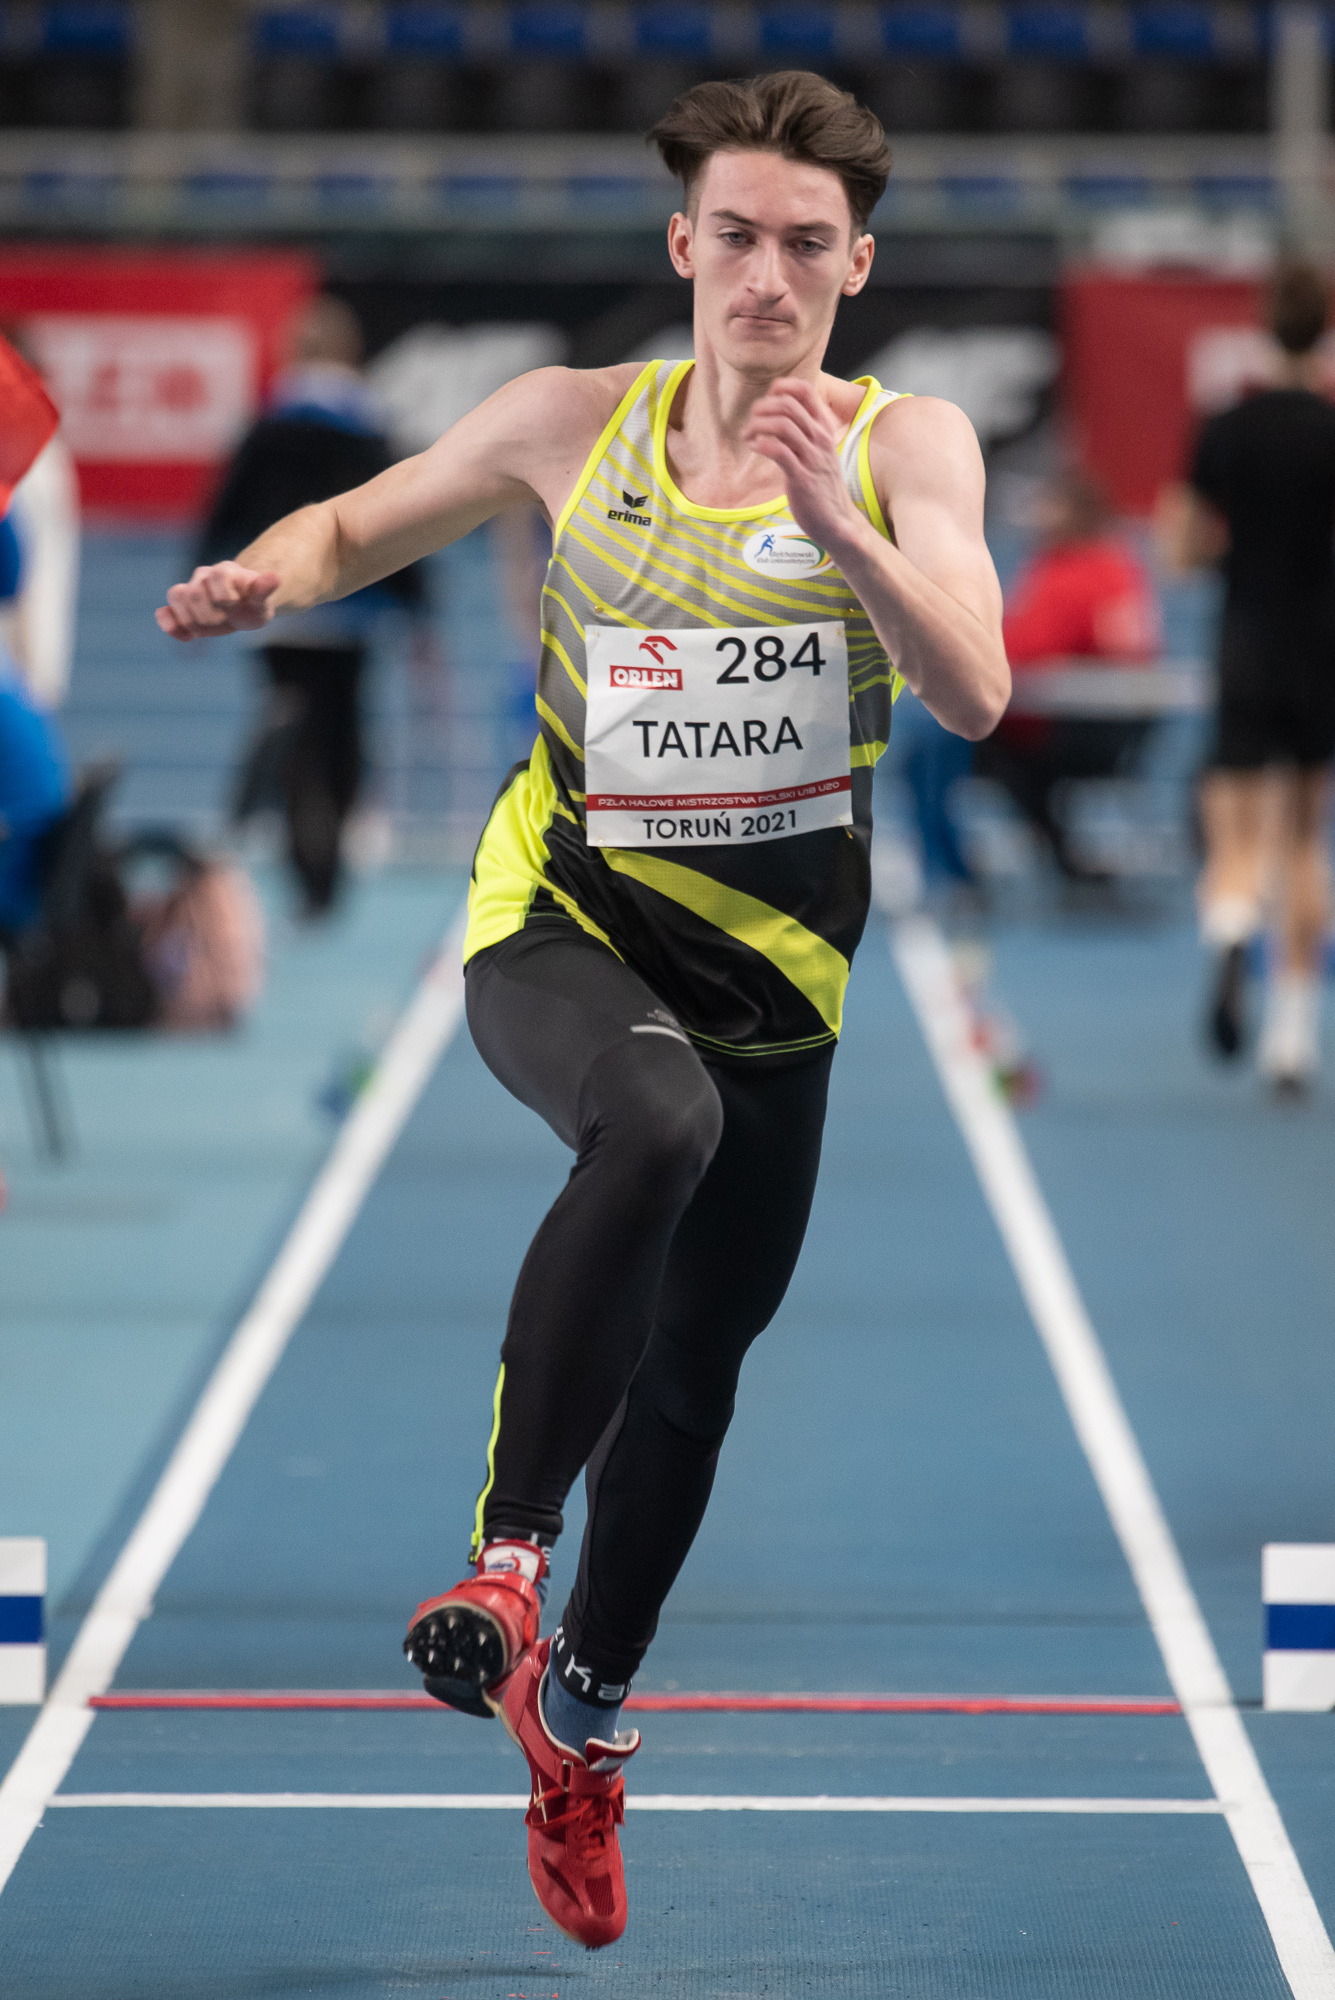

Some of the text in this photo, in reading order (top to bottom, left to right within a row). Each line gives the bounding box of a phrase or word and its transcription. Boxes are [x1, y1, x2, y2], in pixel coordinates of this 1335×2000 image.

[608, 510, 652, 527] erima
[715, 632, 826, 685] 284
[613, 668, 678, 688] ORLEN
[632, 716, 804, 758] TATARA
[598, 781, 840, 808] PZLA HALOWE MISTRZOSTWA POLSKI U18 U20
[643, 809, 796, 839] TORUŃ 2021
